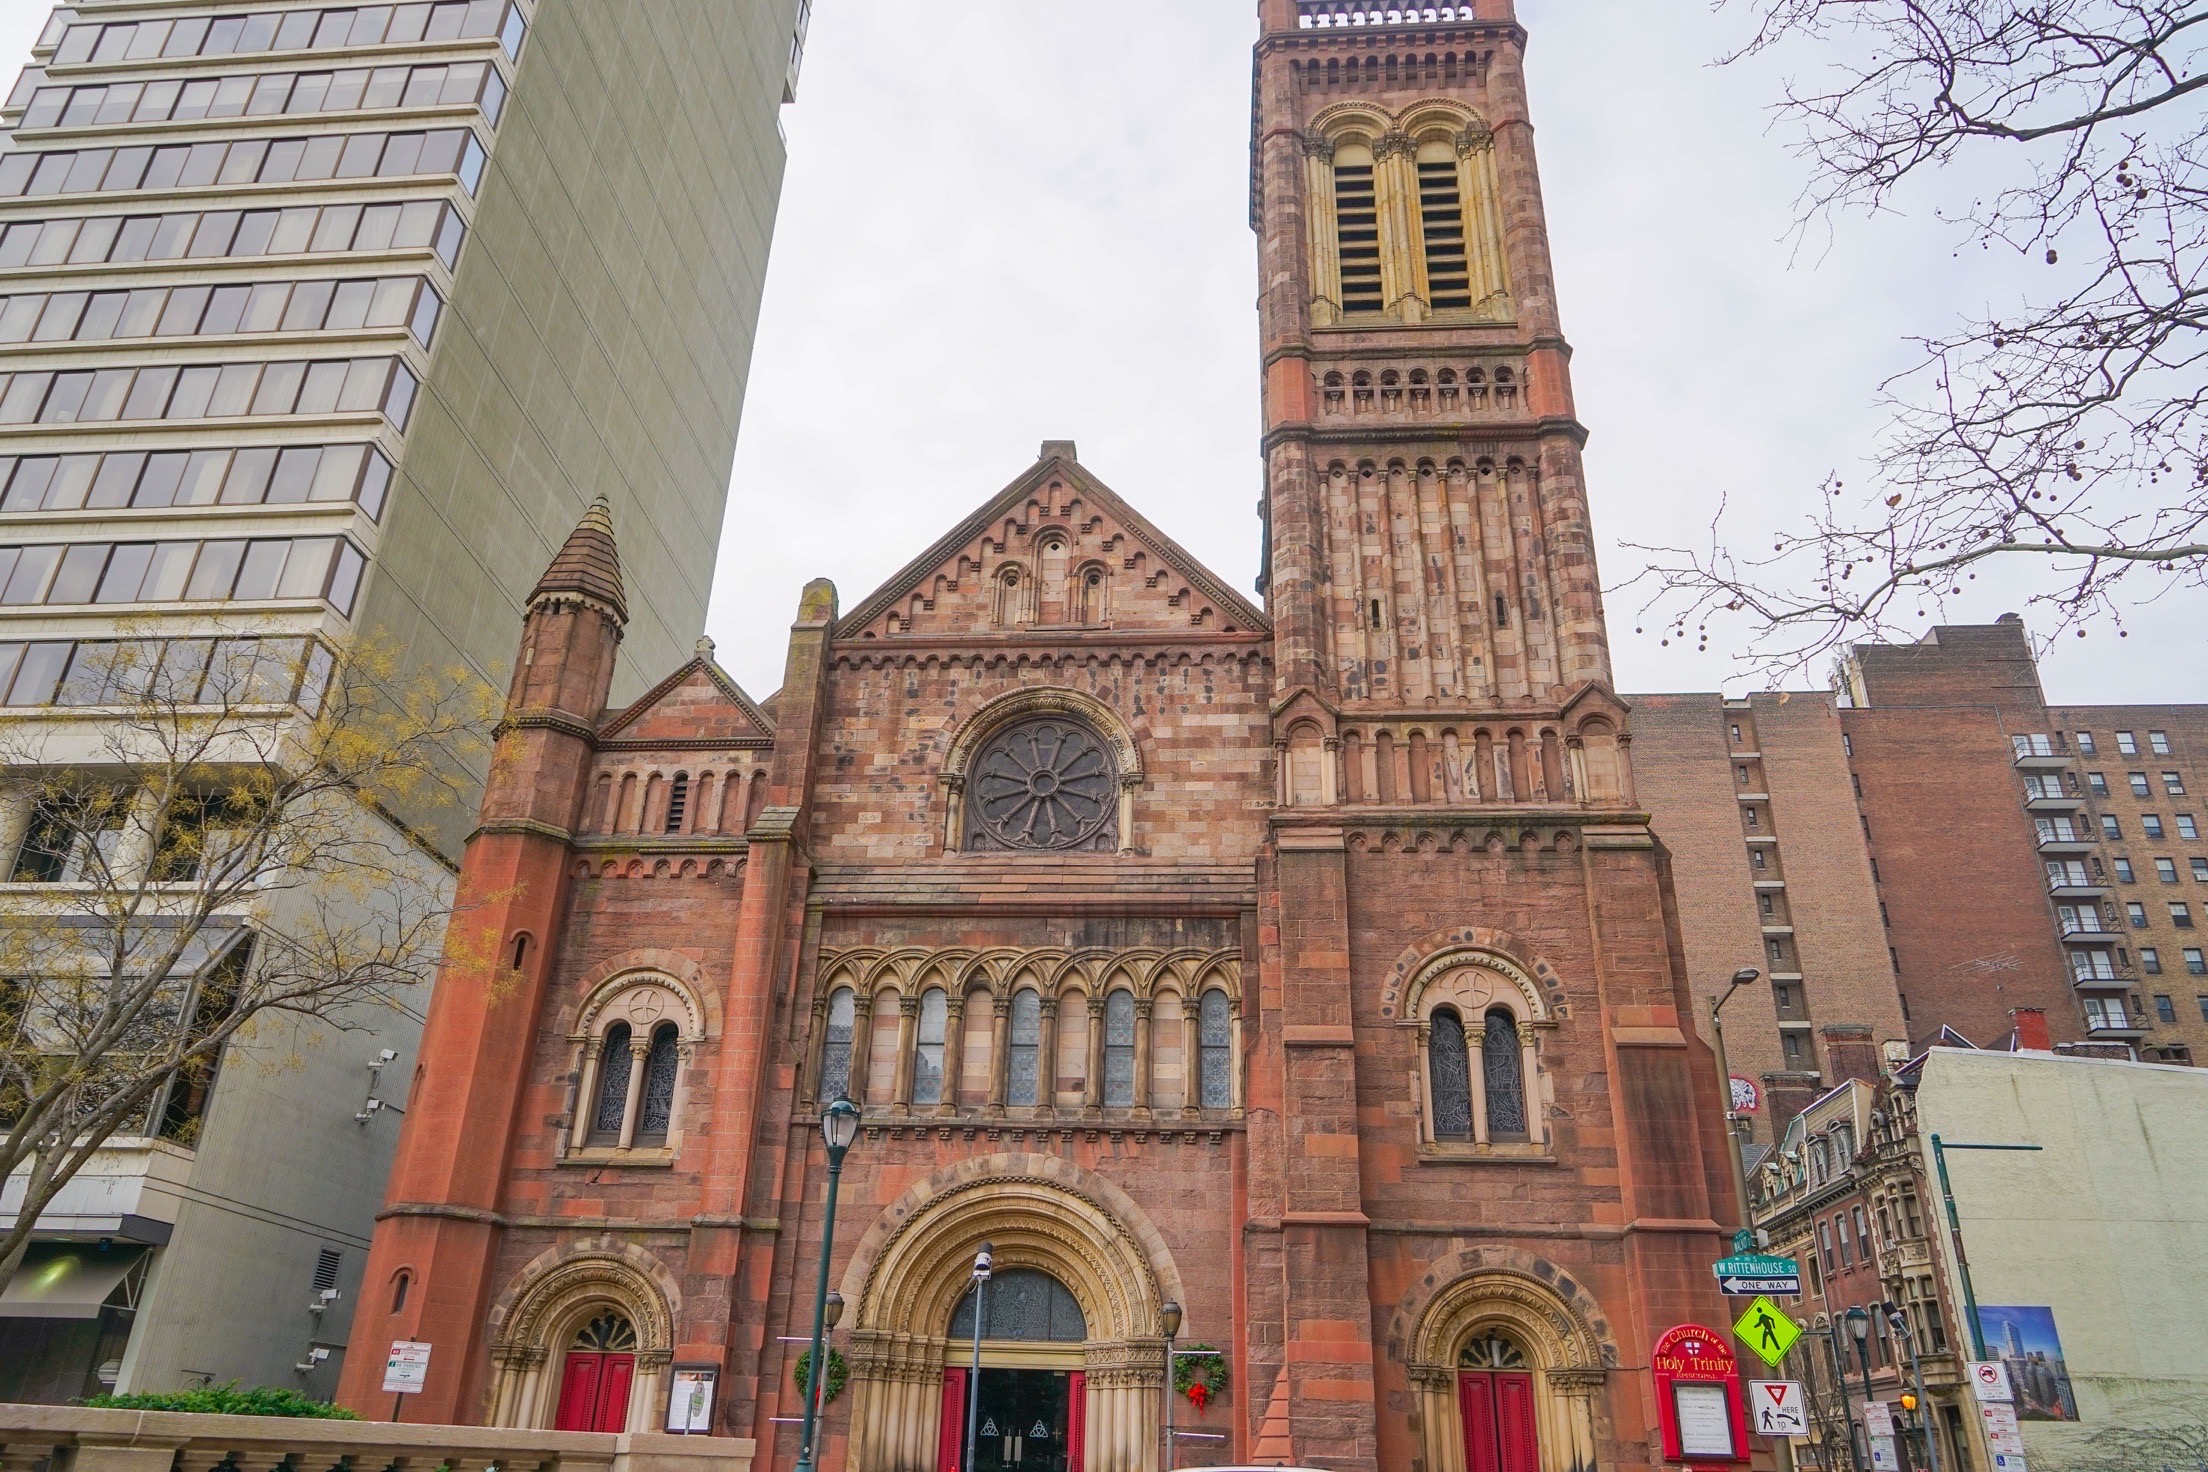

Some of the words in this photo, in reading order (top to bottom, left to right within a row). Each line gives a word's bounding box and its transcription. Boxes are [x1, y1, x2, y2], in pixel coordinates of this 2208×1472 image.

[1718, 1262, 1726, 1273] W
[1728, 1262, 1785, 1274] RITTENHOUSE
[1787, 1265, 1797, 1273] SQ
[1741, 1281, 1762, 1289] ONE
[1766, 1281, 1789, 1289] WAY
[1660, 1341, 1671, 1354] The
[1669, 1329, 1709, 1343] Church
[1717, 1343, 1727, 1355] the
[1656, 1356, 1685, 1373] Holy
[1690, 1357, 1734, 1374] Trinity
